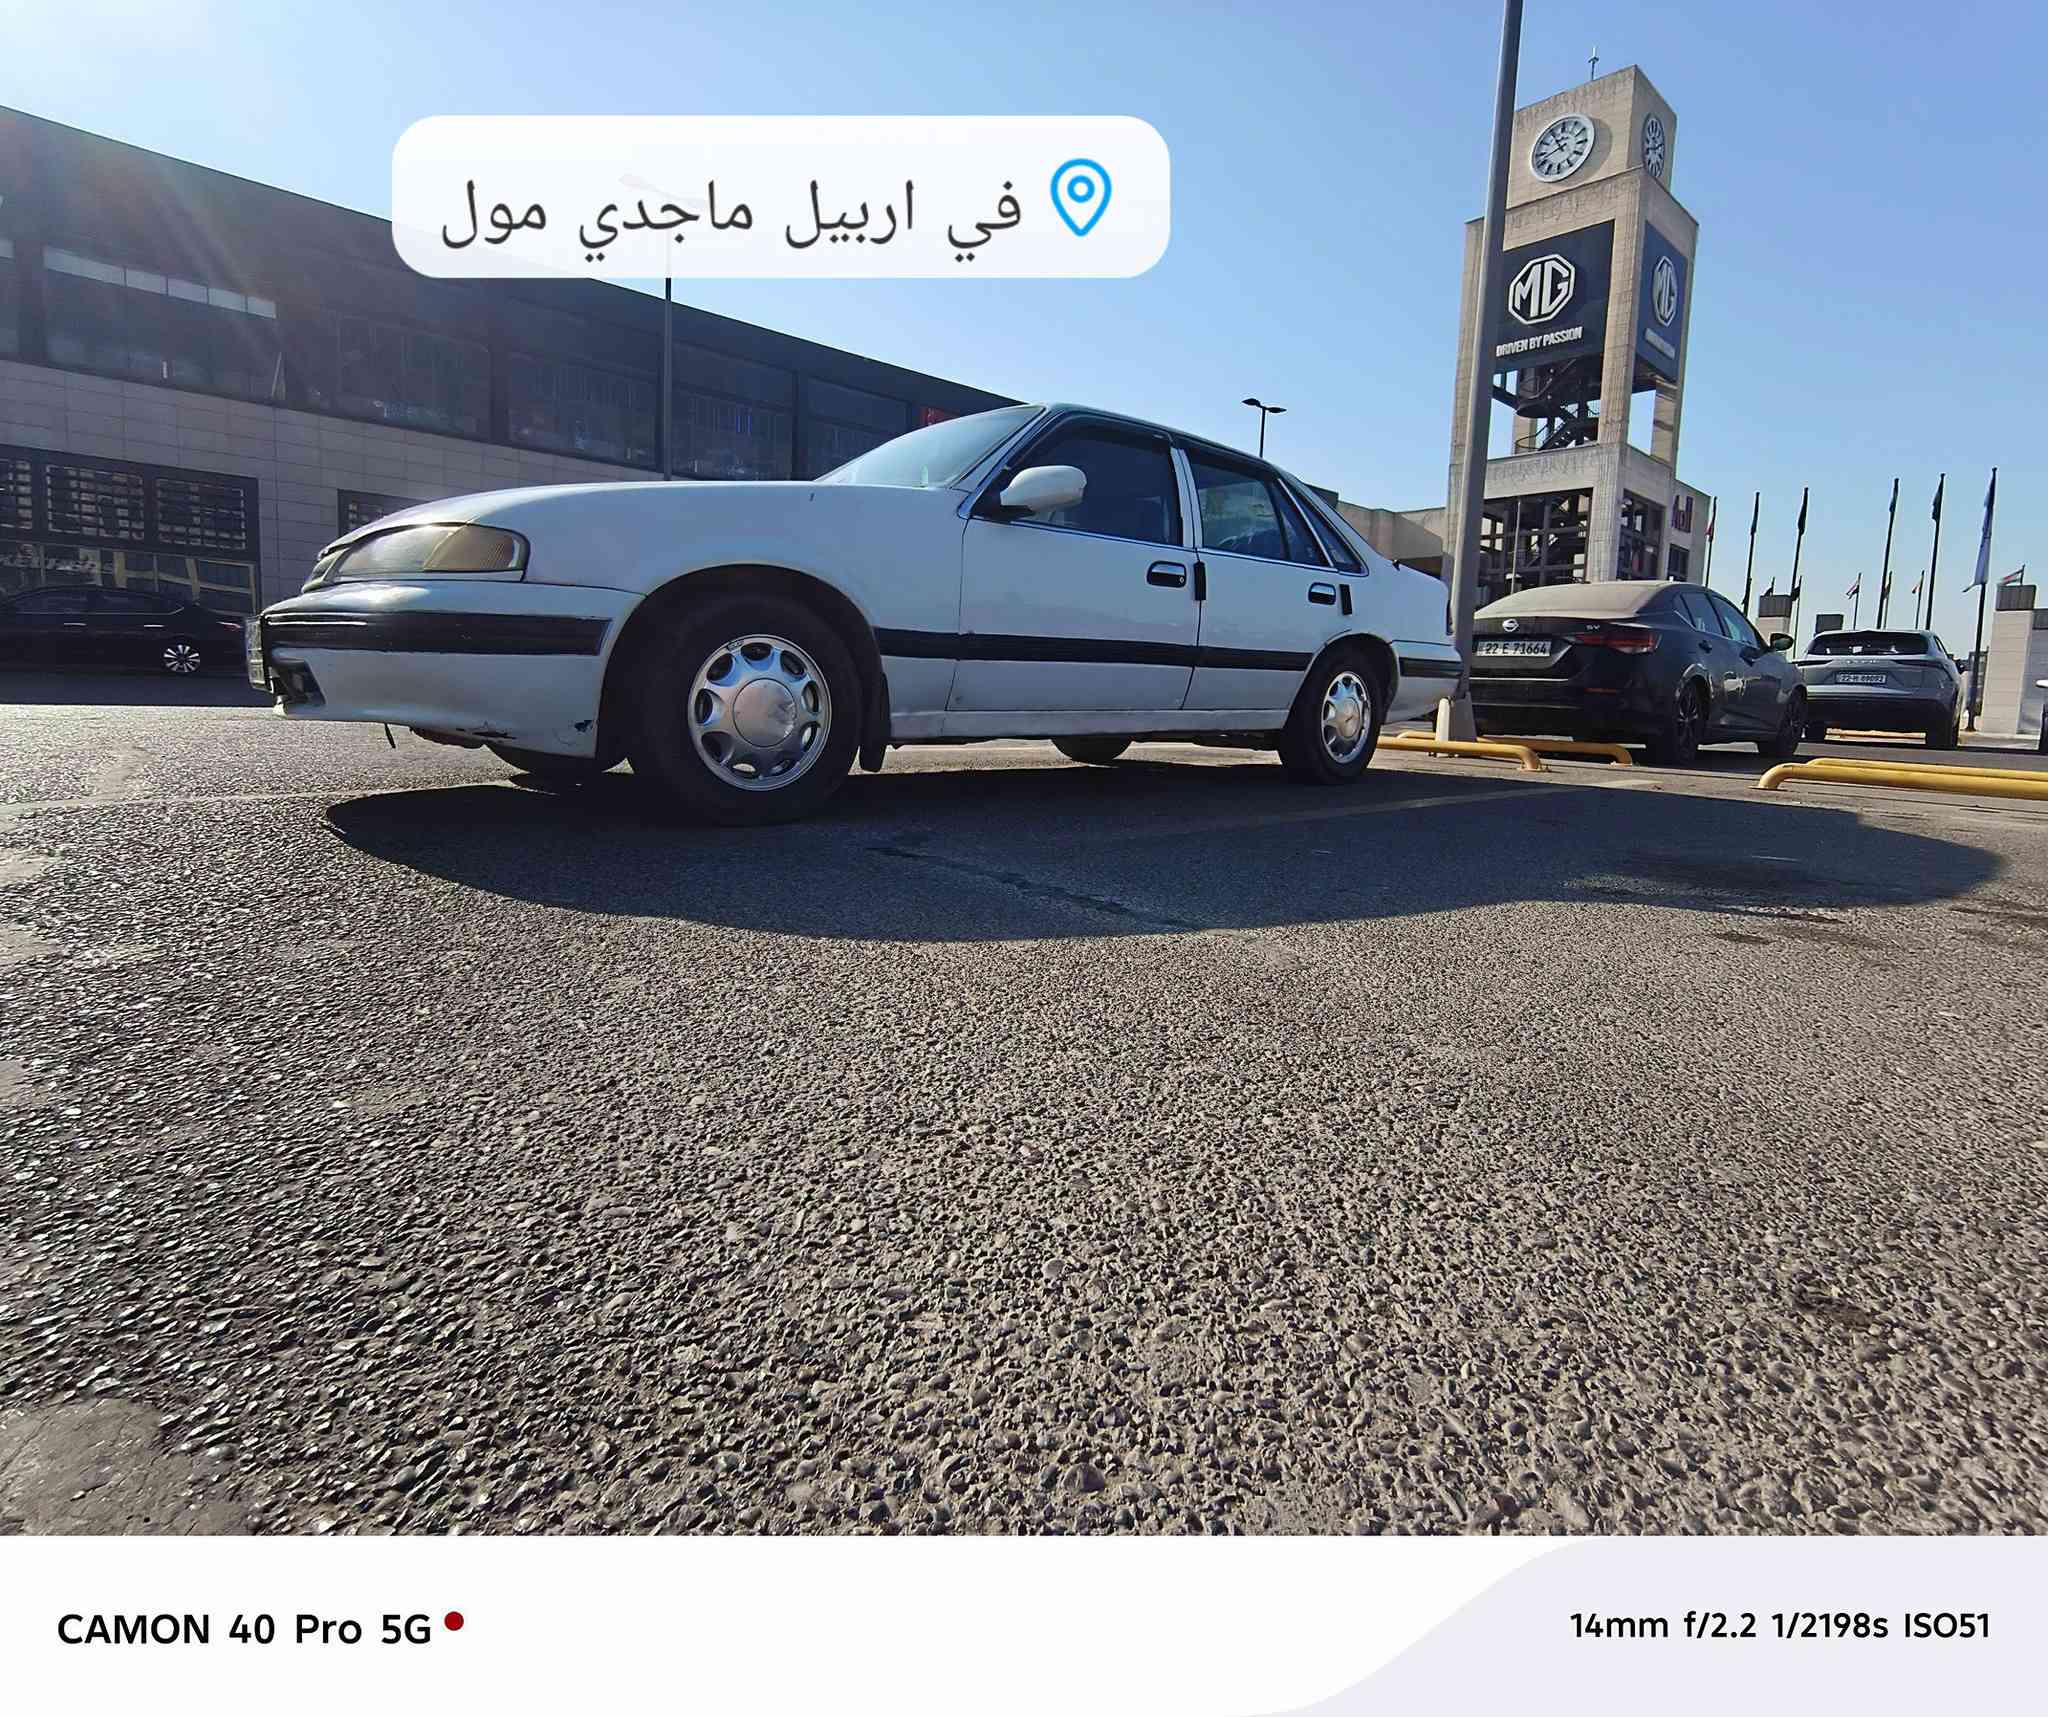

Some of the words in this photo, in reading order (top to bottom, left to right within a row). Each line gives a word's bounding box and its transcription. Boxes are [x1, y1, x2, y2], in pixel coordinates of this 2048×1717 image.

[1514, 257, 1571, 319] MG
[1496, 338, 1528, 357] DRIVEN
[1529, 335, 1542, 350] BY
[1543, 326, 1583, 346] PASSION
[1486, 641, 1497, 654] 22
[1502, 641, 1509, 654] E
[1514, 641, 1546, 654] 71664
